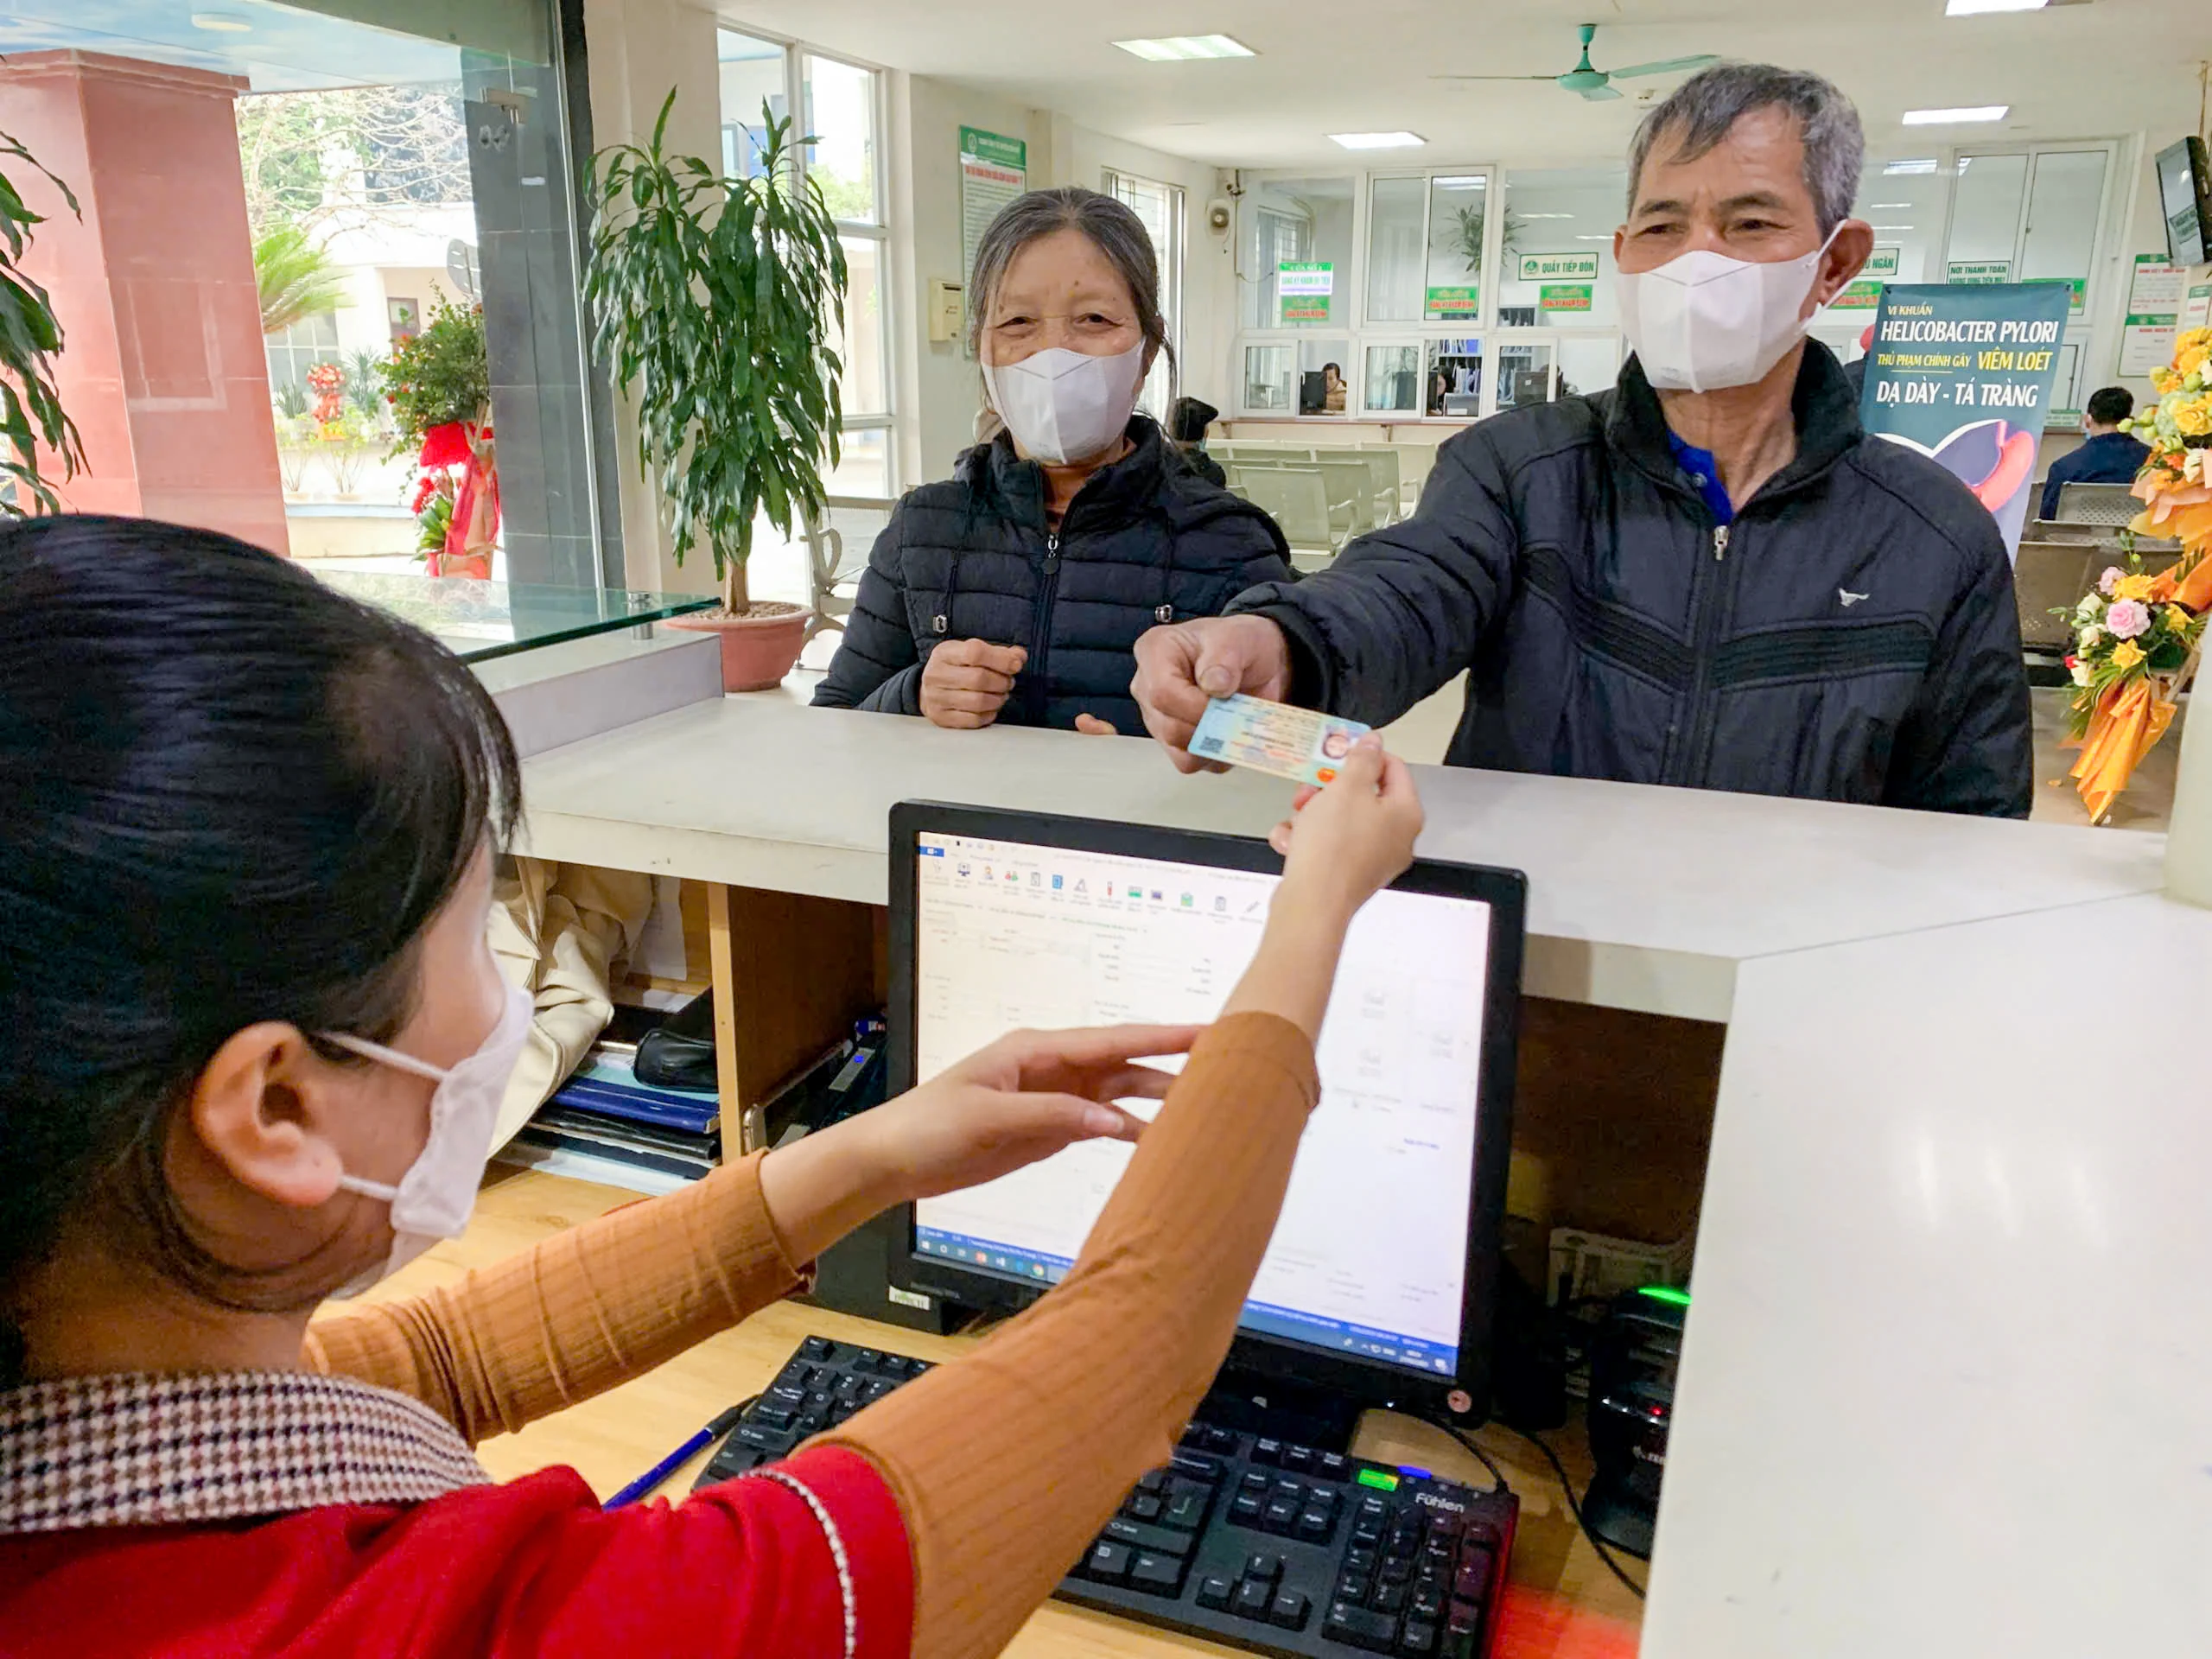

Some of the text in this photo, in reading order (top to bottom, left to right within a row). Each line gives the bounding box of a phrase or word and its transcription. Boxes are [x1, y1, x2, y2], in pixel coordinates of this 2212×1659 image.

[1880, 320, 2059, 343] HELICOBACTER PYLORI
[1896, 354, 1923, 369] PHẠM
[1923, 352, 1951, 367] CHÍNH
[1977, 346, 2012, 371] VIÊM
[2016, 346, 2053, 371] LOÉT
[1876, 380, 1901, 408] DẠ
[1904, 376, 1942, 404] DÀY
[1955, 377, 1976, 406] TÁ
[1980, 378, 2039, 408] TRÀNG
[1414, 1492, 1465, 1514] Fühlen
